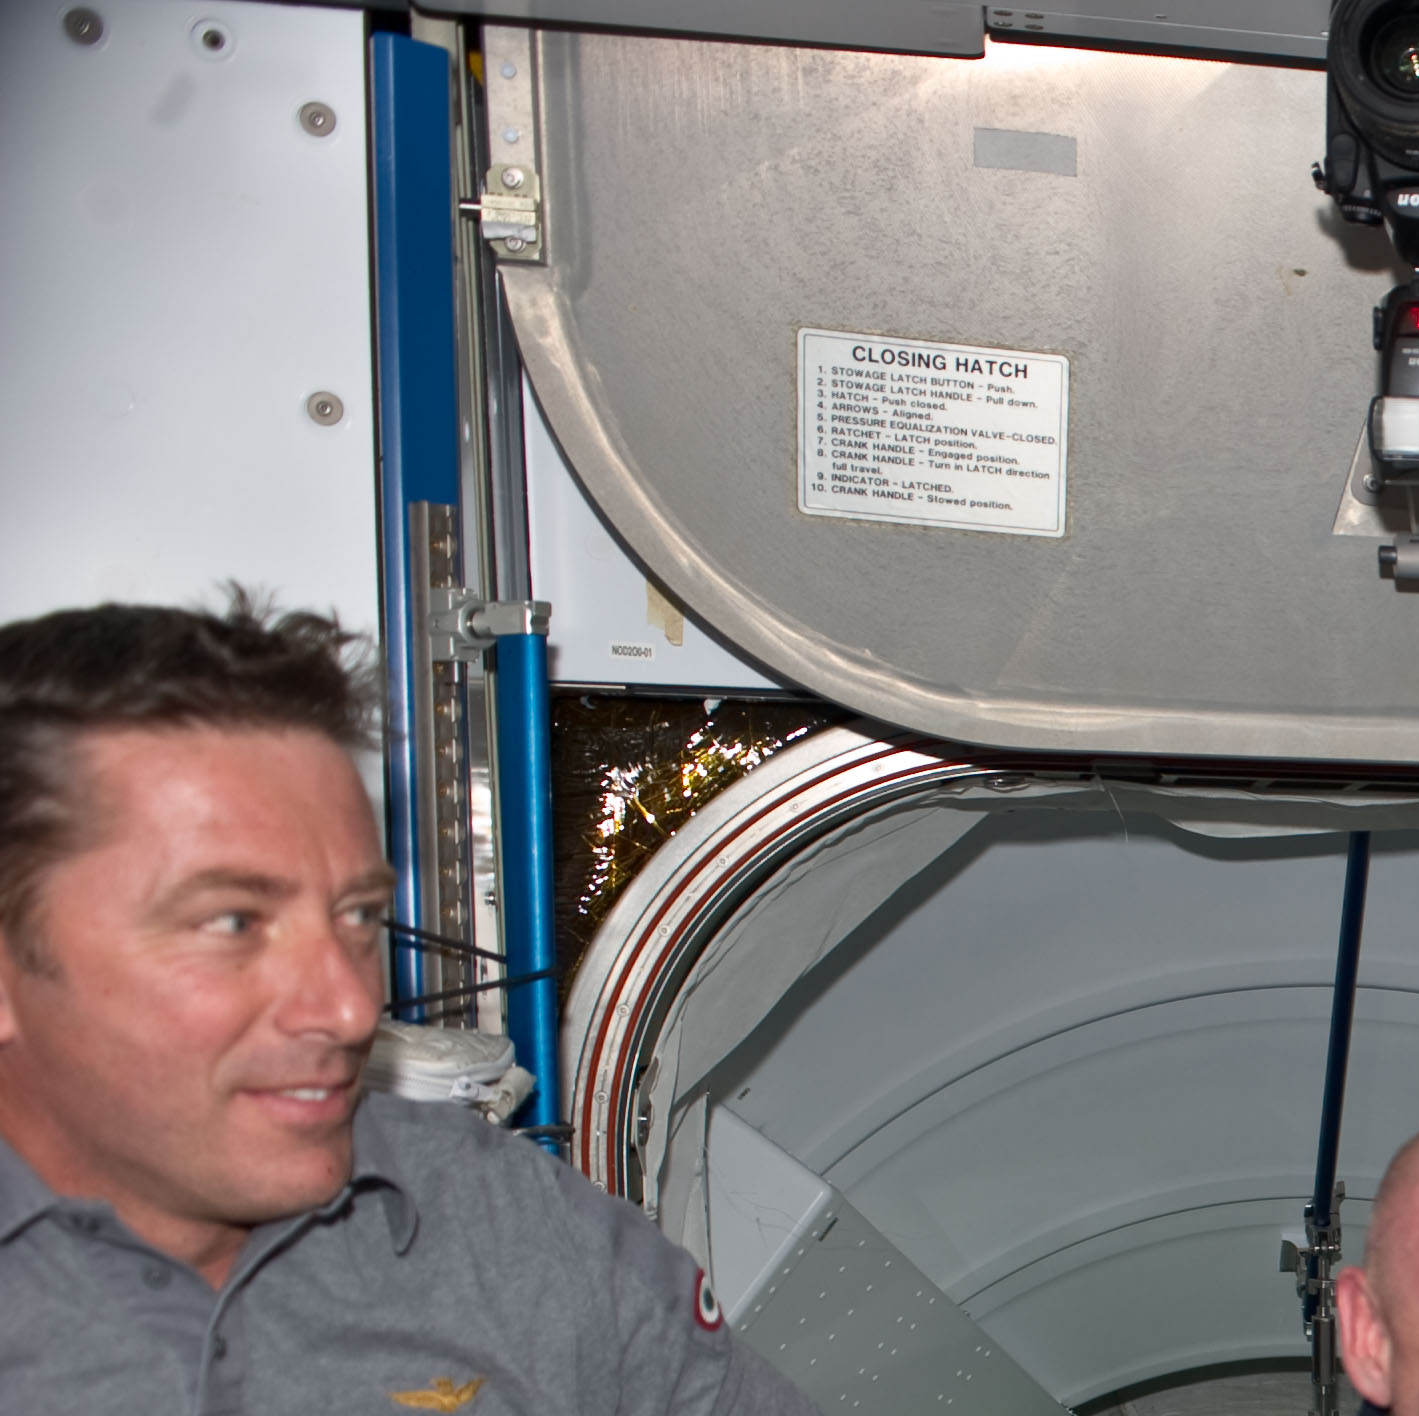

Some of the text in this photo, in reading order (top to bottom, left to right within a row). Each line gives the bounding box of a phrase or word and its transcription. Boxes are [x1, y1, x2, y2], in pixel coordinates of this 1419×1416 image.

[852, 345, 1028, 379] CLOSING HATCH
[817, 377, 827, 387] 2.
[831, 379, 886, 393] STOWAGE
[890, 386, 927, 397] LATCH
[930, 390, 973, 402] HANDLE
[986, 395, 1004, 405] Pull
[1007, 399, 1038, 408] down.
[818, 365, 827, 375] 1.
[831, 366, 887, 380] STOWAGE
[891, 373, 927, 384] LATCH
[931, 378, 974, 389] BUTTON
[987, 384, 1015, 394] Push.
[817, 389, 827, 398] 3.
[831, 391, 868, 402] HATCH
[882, 396, 907, 406] Push
[910, 400, 948, 411] closed.
[817, 401, 827, 410] 4.
[832, 402, 879, 415] ARROWS
[892, 409, 933, 421] Aligned.
[817, 413, 1057, 445] 5. PRESSURE EQUALIZATION VALVE-CLOSED.
[817, 425, 827, 434] 6.
[831, 426, 882, 439] RATCHET
[894, 433, 930, 444] LATCH
[934, 438, 978, 450] position.
[817, 436, 827, 446] 7.
[831, 438, 868, 450] CRANK
[873, 443, 915, 454] HANDLE
[928, 448, 973, 460] Engaged
[976, 454, 1020, 465] position.
[817, 448, 827, 457] 8.
[831, 449, 868, 461] CRANK
[872, 455, 915, 466] HANDLE
[928, 460, 951, 470] Turn
[966, 464, 1002, 475] LATCH
[1006, 468, 1050, 479] direction
[817, 472, 827, 481] 9.
[831, 473, 889, 487] INDICATOR
[901, 481, 954, 493] LATCHED.
[832, 462, 883, 475] full travel.
[811, 483, 827, 492] 10.
[831, 485, 868, 496] CRANK
[872, 489, 914, 501] HANDLE
[927, 494, 966, 506] Stowed
[969, 500, 1013, 511] position.
